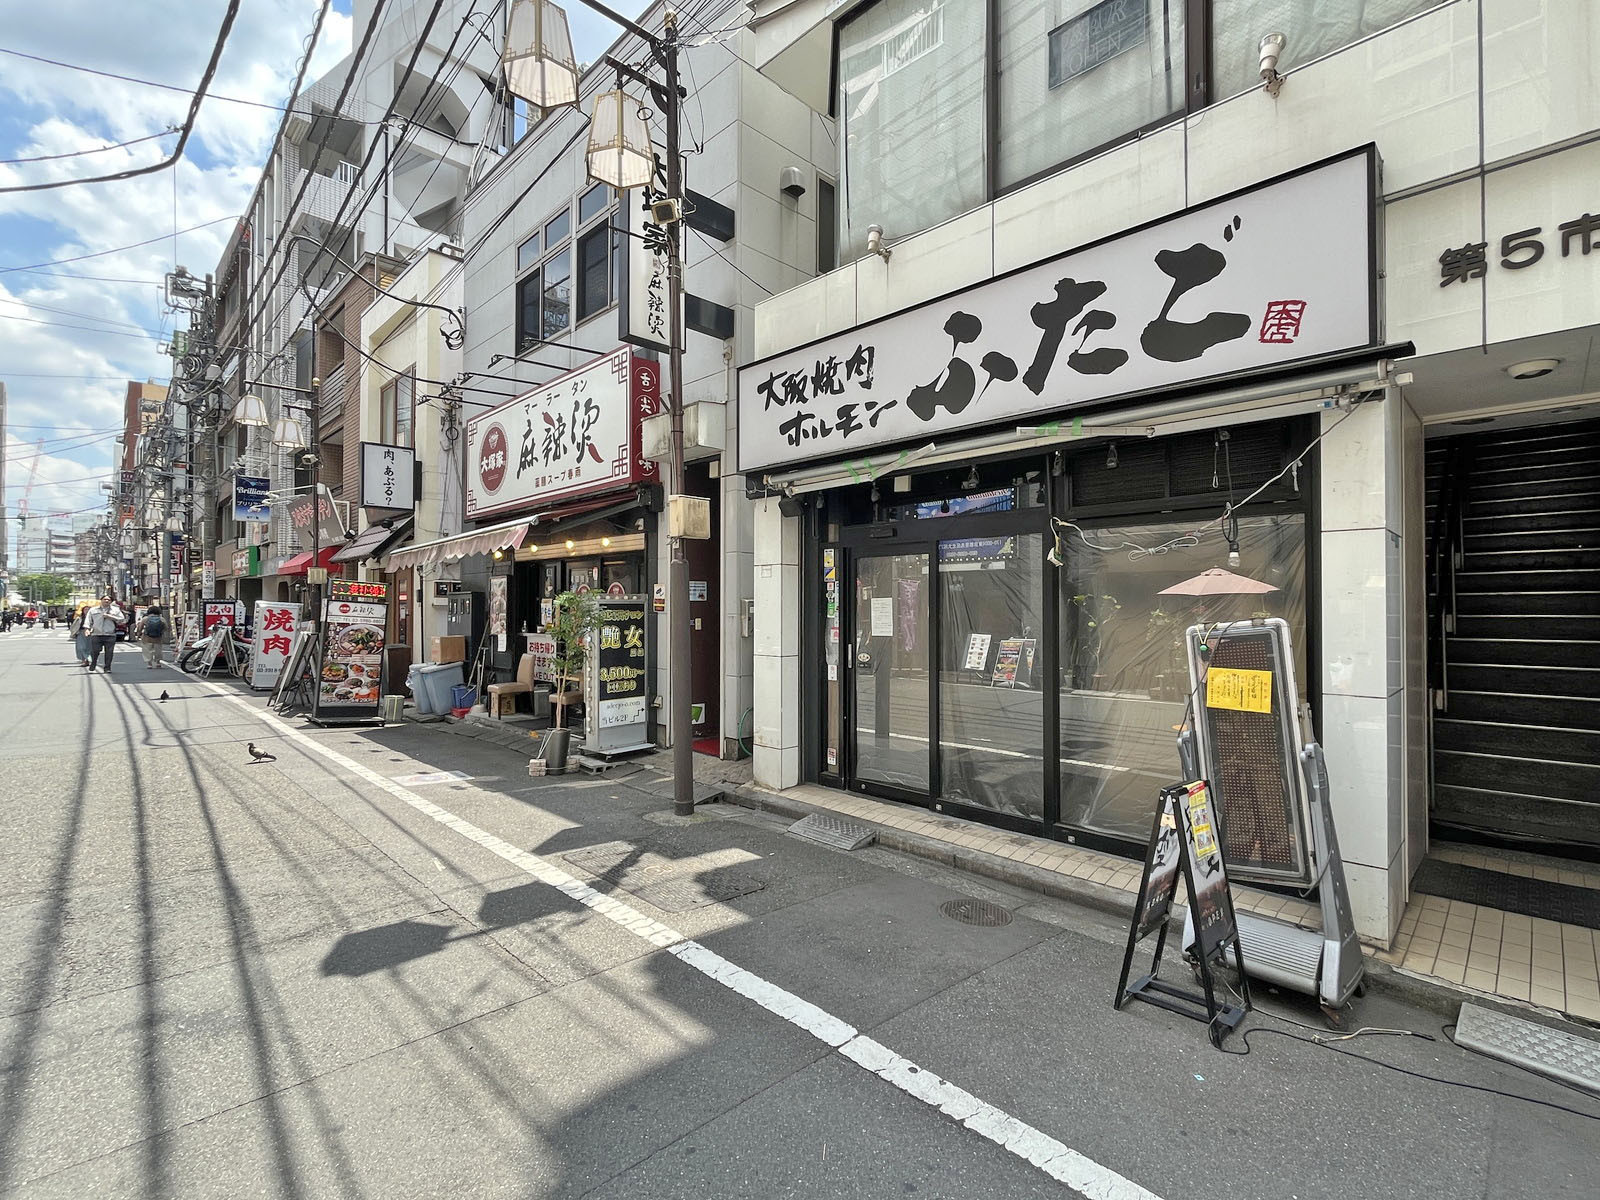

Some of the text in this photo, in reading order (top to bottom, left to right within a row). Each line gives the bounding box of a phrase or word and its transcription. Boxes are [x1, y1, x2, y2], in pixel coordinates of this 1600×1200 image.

[906, 214, 1251, 422] ふたご
[757, 344, 875, 411] 大阪焼肉
[779, 399, 898, 447] ホルモン
[480, 450, 504, 474] 大塚家
[262, 608, 295, 656] 焼肉
